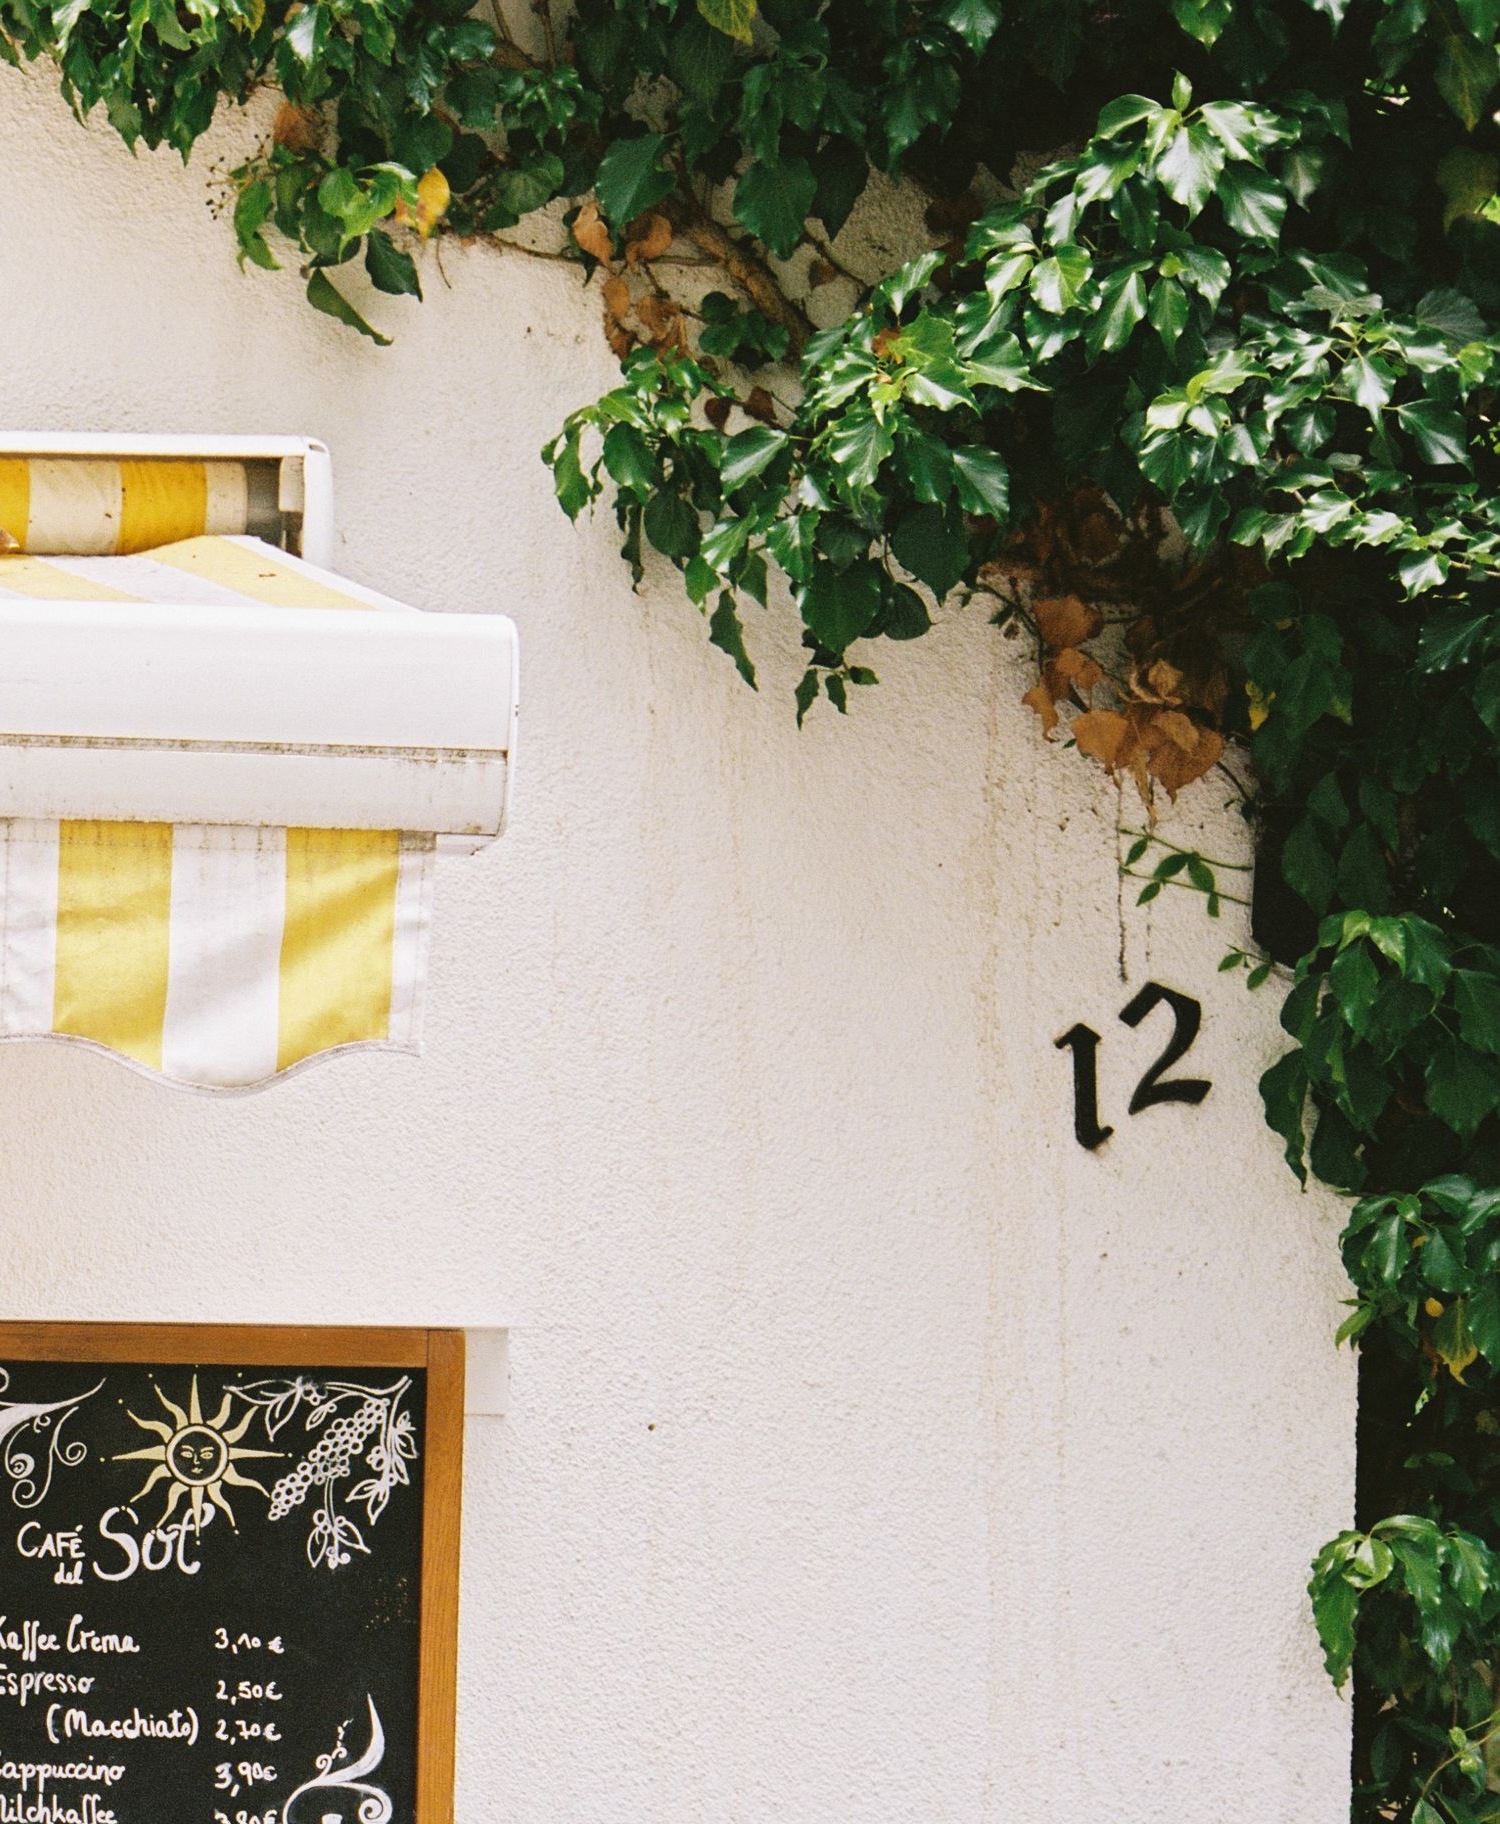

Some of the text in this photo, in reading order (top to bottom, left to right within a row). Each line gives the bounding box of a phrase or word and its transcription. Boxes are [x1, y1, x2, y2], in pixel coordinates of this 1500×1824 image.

[1054, 982, 1212, 1150] 12
[16, 1502, 216, 1585] CAFÉ del Sol
[66, 1613, 141, 1654] Crema
[214, 1627, 262, 1655] 3,10
[267, 1635, 286, 1655] €
